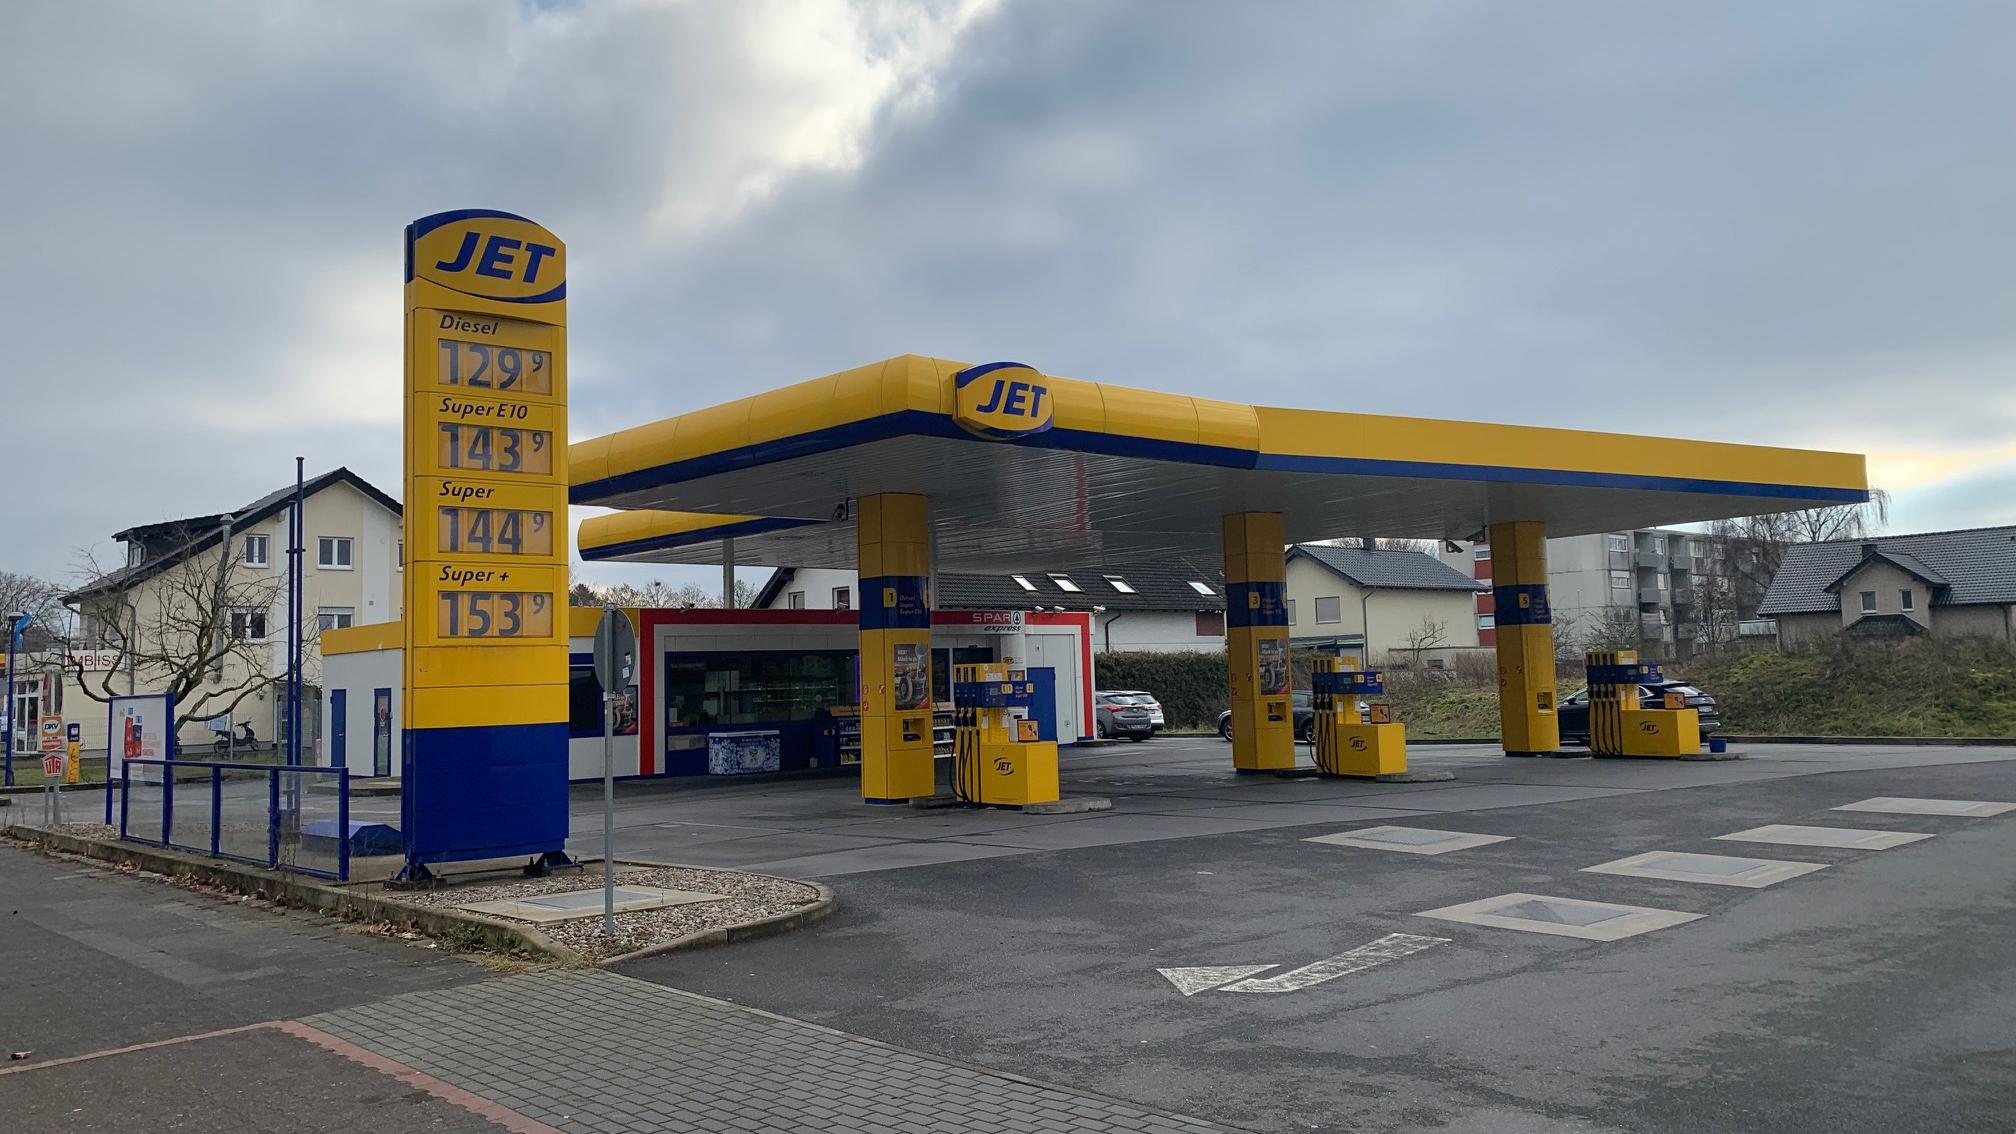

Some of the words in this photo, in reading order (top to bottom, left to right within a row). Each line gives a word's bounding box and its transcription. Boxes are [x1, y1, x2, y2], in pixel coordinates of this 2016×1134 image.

[435, 231, 556, 284] JET
[439, 314, 498, 335] Diesel
[439, 398, 495, 419] Super
[496, 403, 528, 419] E10
[975, 379, 1047, 418] JET
[439, 481, 495, 502] Super
[439, 565, 495, 586] Super
[972, 612, 1011, 622] SPAR
[44, 723, 59, 731] DKV
[45, 755, 61, 774] UTA
[995, 761, 1012, 771] JET
